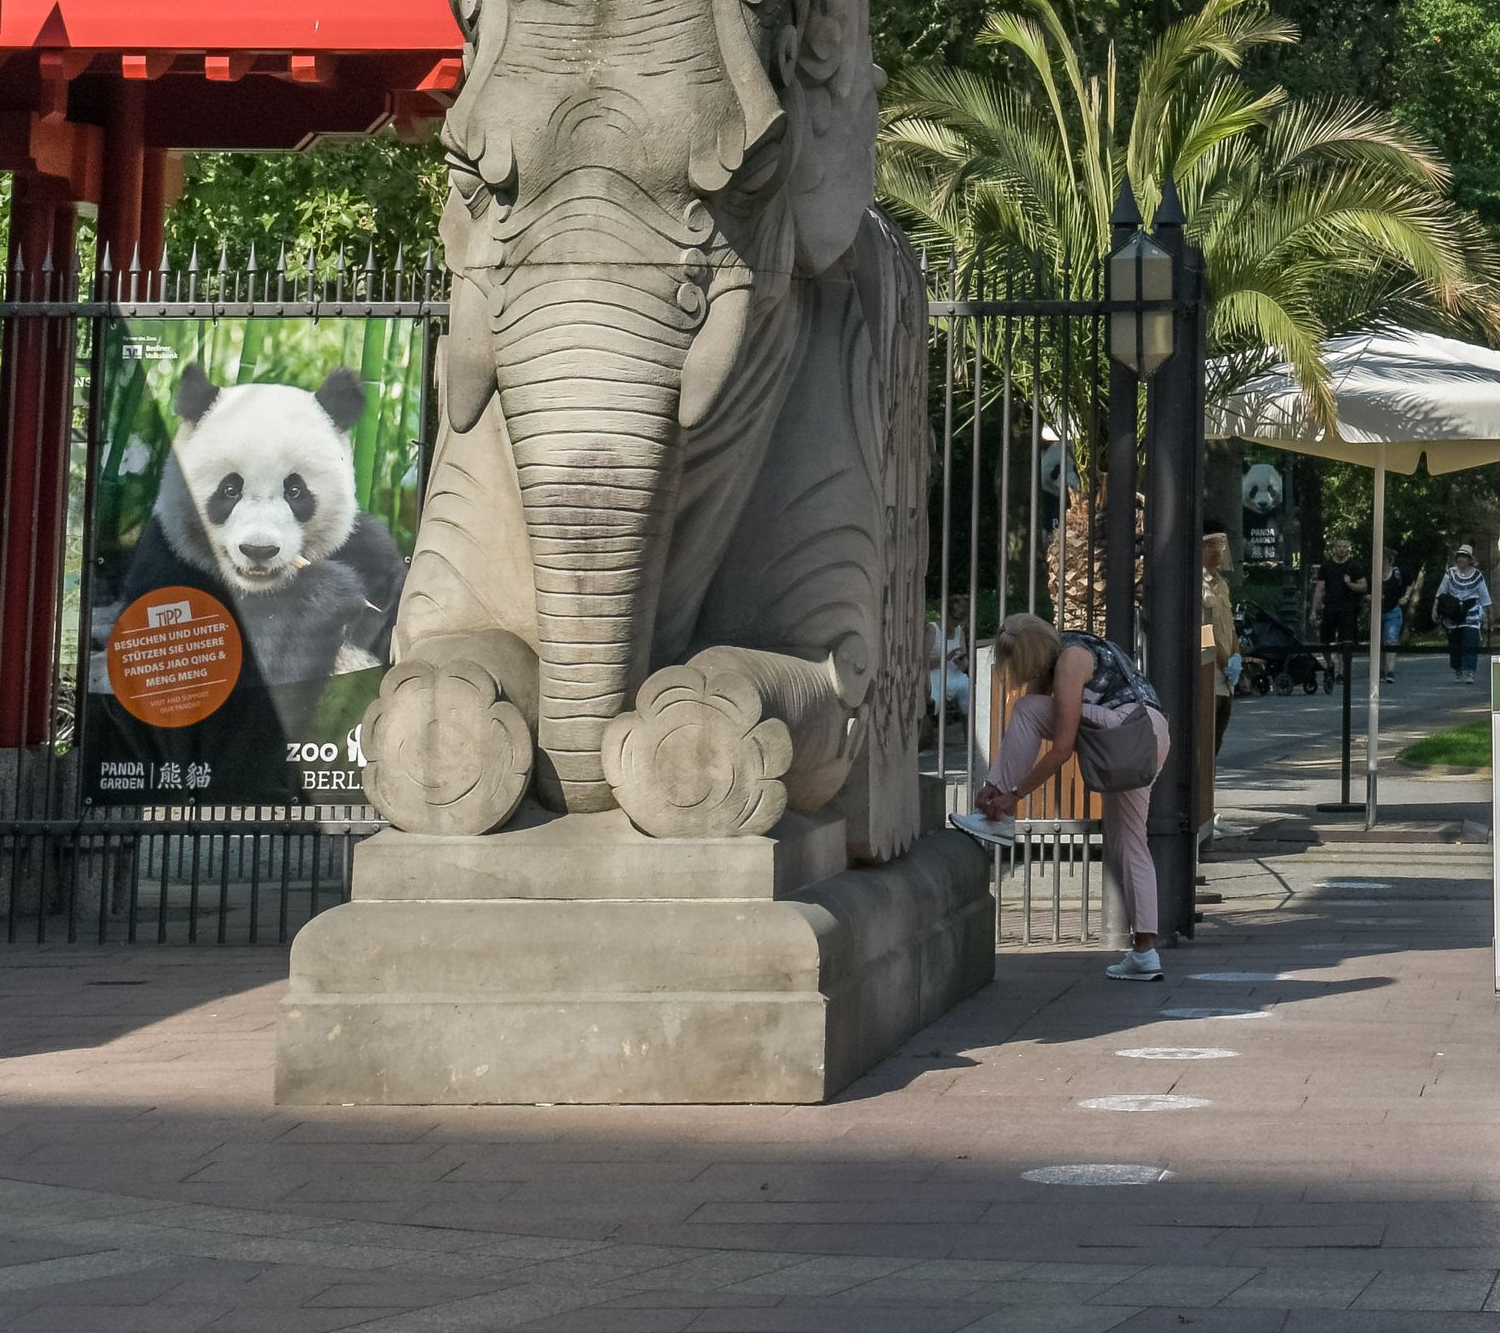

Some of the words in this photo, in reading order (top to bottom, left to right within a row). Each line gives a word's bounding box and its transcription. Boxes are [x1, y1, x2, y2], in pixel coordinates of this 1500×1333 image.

[145, 344, 171, 352] Berliner
[145, 351, 178, 359] Volksbank
[155, 608, 183, 627] TIPP
[114, 633, 167, 651] BESUCHEN
[168, 629, 191, 642] UND
[193, 622, 229, 636] UNTER-
[122, 646, 167, 664] STÜTZEN
[168, 644, 184, 655] SIE
[186, 636, 225, 652] UNSERE
[124, 662, 165, 677] PANDAS
[166, 658, 189, 671] JIAO
[191, 654, 216, 667] QING
[217, 650, 227, 660] &
[145, 673, 176, 688] MENG
[178, 668, 208, 682] MENG
[286, 742, 338, 762] ZOO
[101, 762, 144, 776] PANDA
[157, 762, 212, 790] 熊貓
[100, 777, 144, 790] GARDEN
[302, 770, 364, 789] BERL
